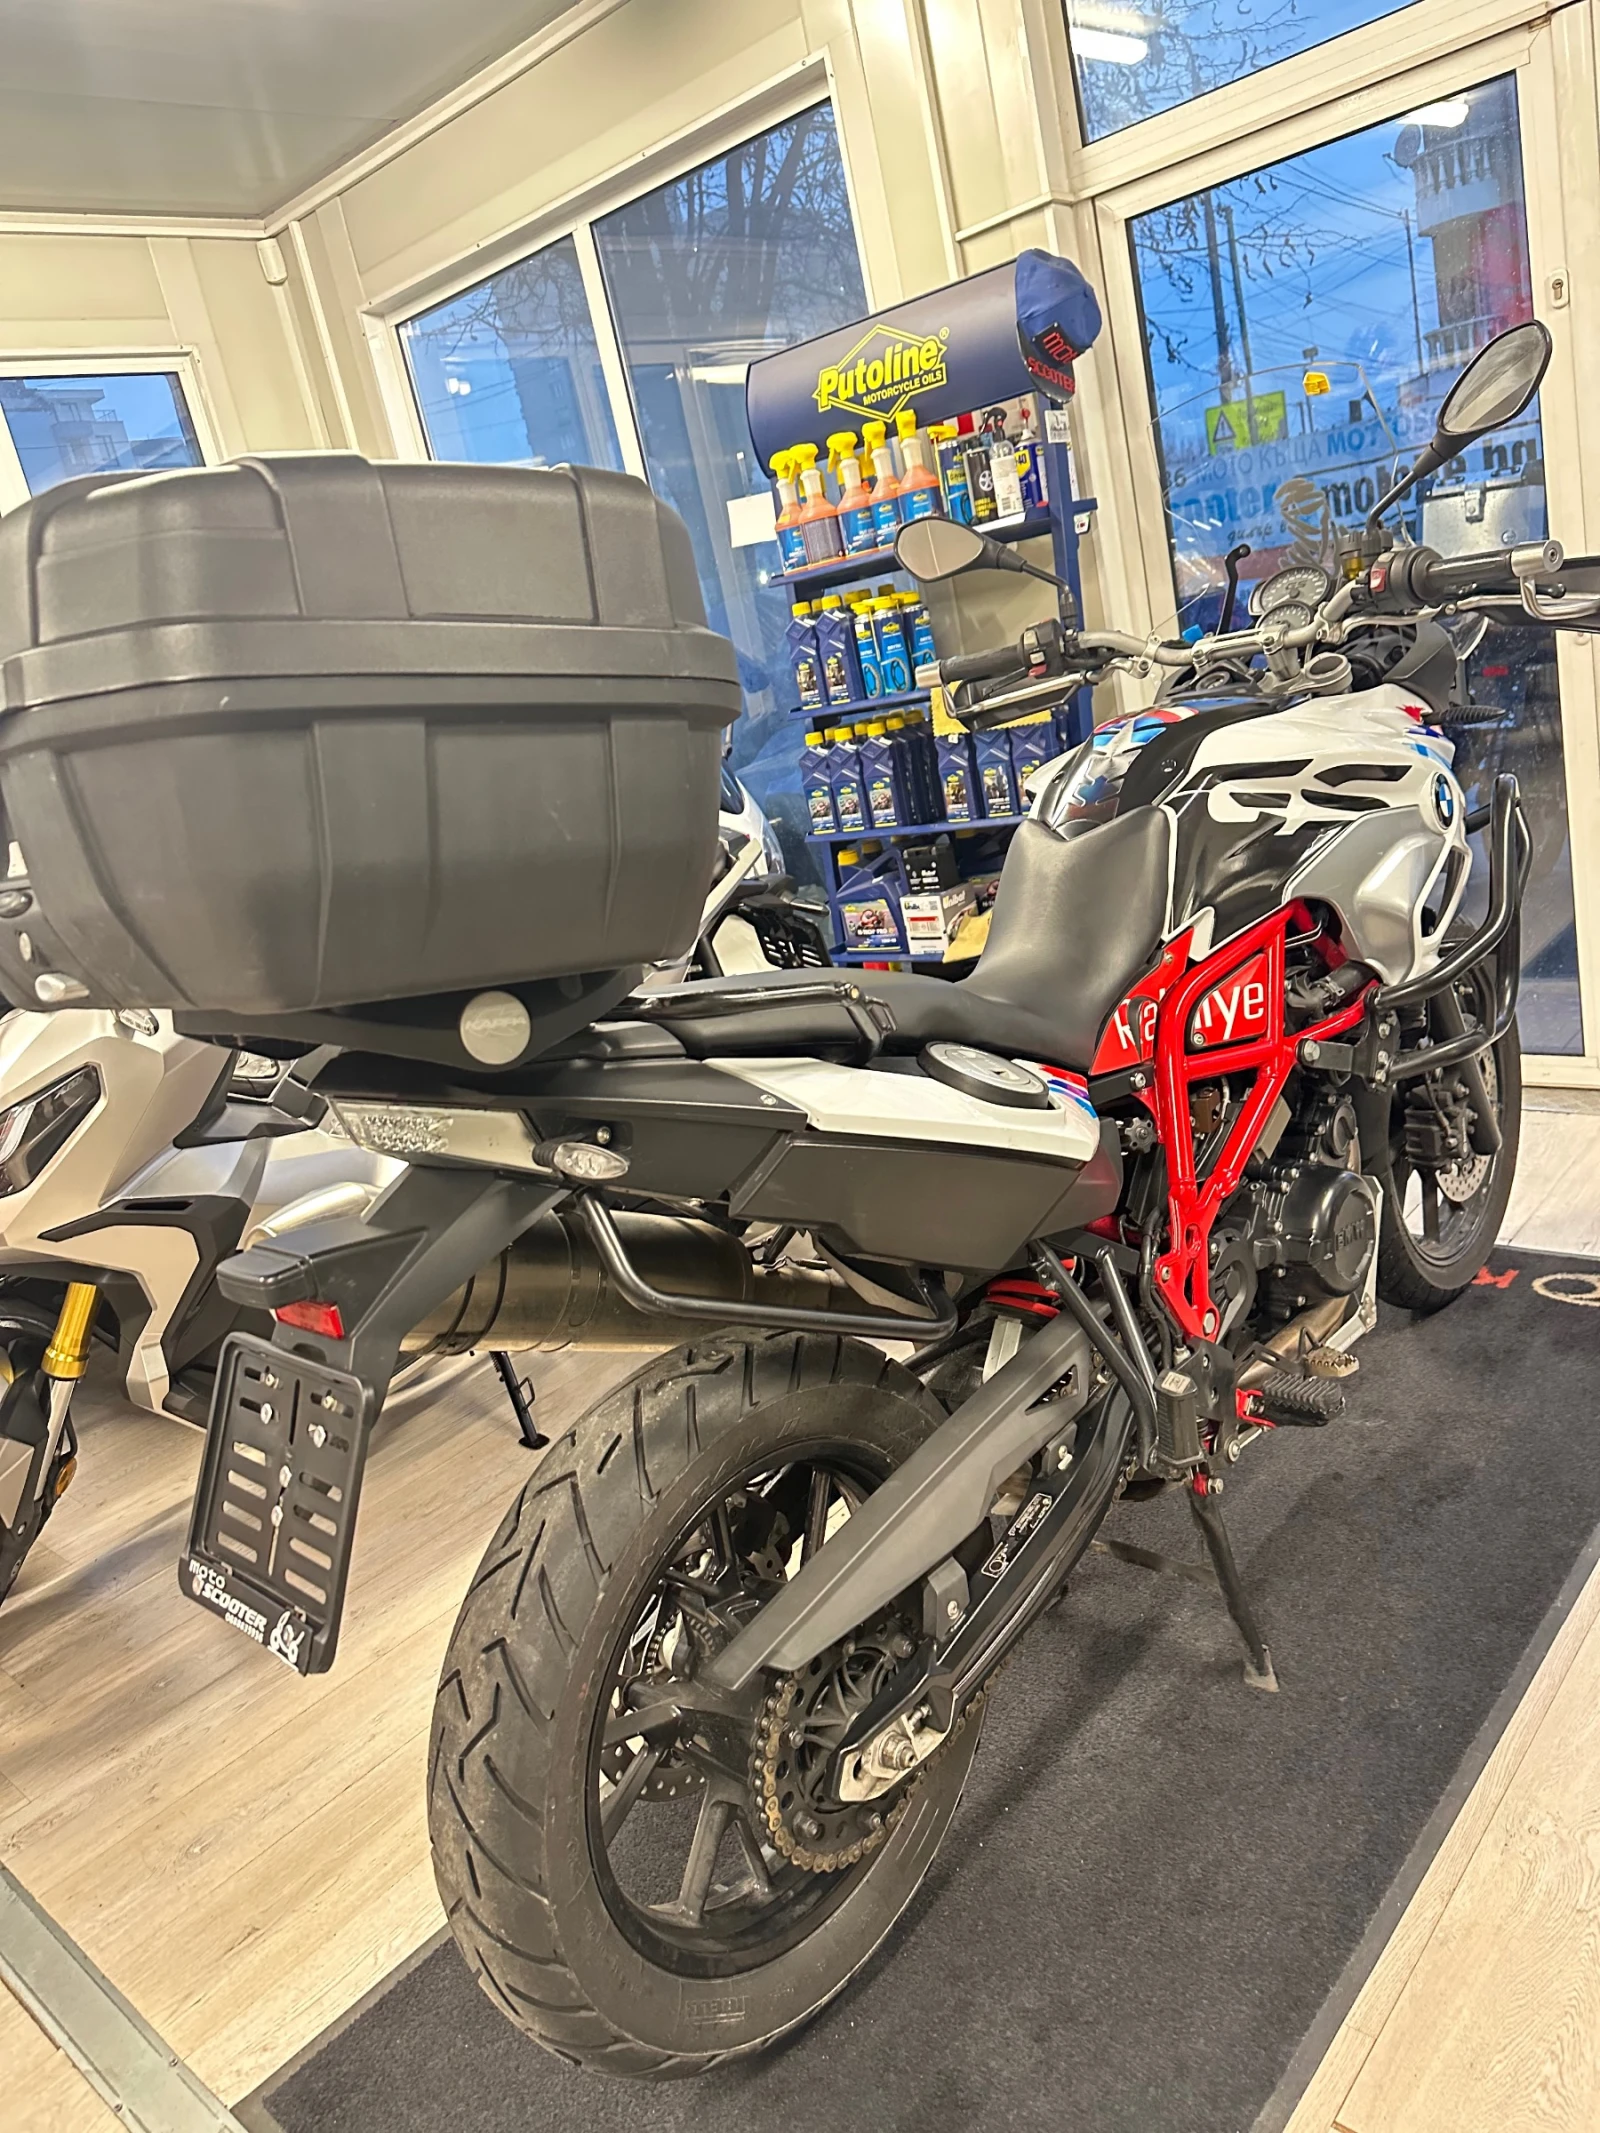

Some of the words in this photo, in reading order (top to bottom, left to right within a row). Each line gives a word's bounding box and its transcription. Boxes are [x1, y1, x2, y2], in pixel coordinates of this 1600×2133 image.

[819, 339, 940, 410] Putoline
[862, 378, 921, 407] MOTORCYCLE
[921, 370, 943, 385] OILS
[189, 1558, 226, 1590] moto
[202, 1581, 268, 1633] SCOOTER
